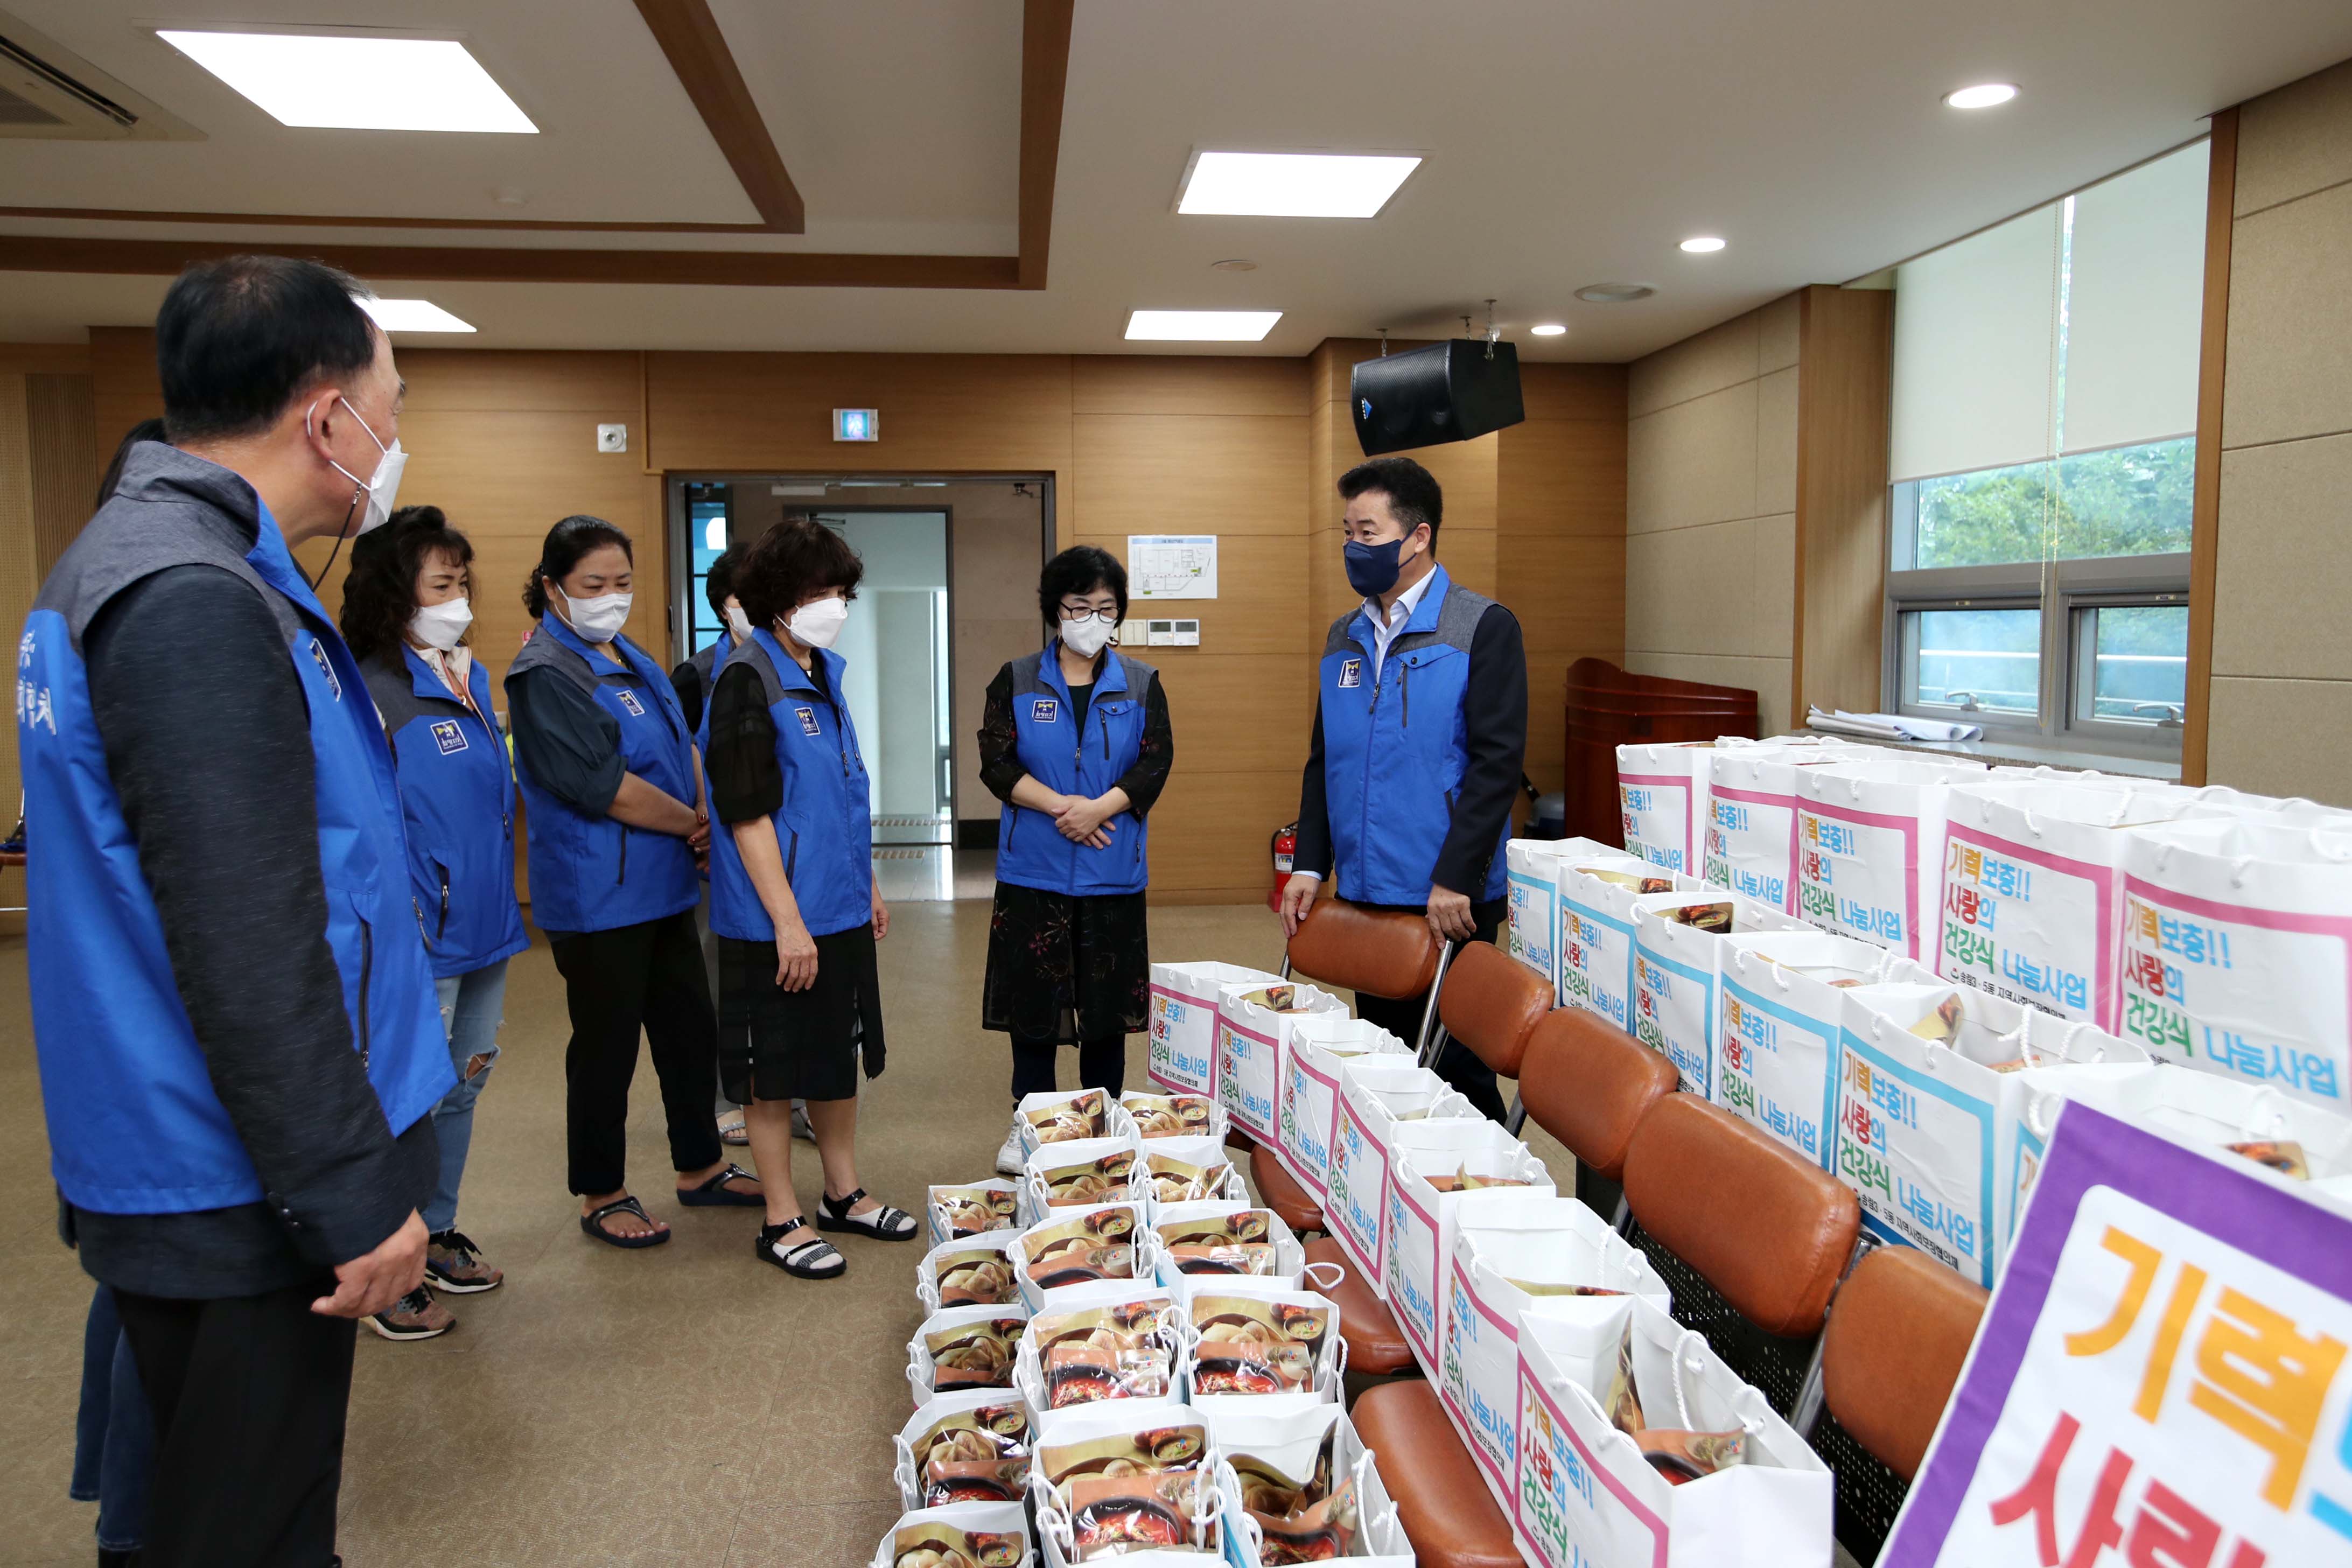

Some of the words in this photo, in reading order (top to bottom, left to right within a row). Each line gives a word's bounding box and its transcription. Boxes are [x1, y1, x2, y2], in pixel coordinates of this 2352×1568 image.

[1707, 825, 1726, 858] 사랑의
[1800, 813, 1854, 856] 기력보충!!
[1706, 855, 1730, 890] 건강식
[1734, 869, 1783, 905] 나눔사업
[1800, 848, 1832, 885] 사랑의
[1950, 843, 2030, 902] 기력보충!!
[1564, 911, 1602, 950] 기력보충!!
[1801, 881, 1836, 921] 건강식
[1840, 898, 1902, 941] 나눔사업
[1945, 882, 1996, 932] 사랑의
[2127, 898, 2231, 969] 기력보충!!
[1524, 940, 1551, 970] 나눔사업
[1564, 939, 1587, 972] 사랑의
[1945, 921, 1994, 974] 건강식
[2003, 948, 2086, 1011] 나눔사업
[2125, 946, 2186, 1006] 사랑의
[1153, 995, 1186, 1024] 기력보충!!
[1564, 965, 1590, 1002] 건강식
[1592, 983, 1624, 1024] 나눔사업
[1636, 982, 1659, 1023] 사랑의
[1724, 992, 1777, 1053] 기력보충!!
[1151, 1039, 1170, 1065] 건강식
[1172, 1050, 1207, 1077] 나눔사업
[1152, 1017, 1171, 1042] 사랑의
[1637, 1012, 1665, 1055] 건강식
[1665, 1036, 1704, 1084] 나눔사업
[1723, 1029, 1753, 1077] 사랑의
[2126, 992, 2193, 1058] 건강식
[2203, 1026, 2341, 1099] 나눔사업
[1221, 1050, 1237, 1077] 사랑의
[1844, 1051, 1917, 1130] 기력보충!!
[1221, 1074, 1239, 1103] 건강식
[1241, 1088, 1271, 1121] 나눔사업
[1285, 1081, 1296, 1116] 사랑의
[1722, 1065, 1755, 1117] 건강식
[1760, 1094, 1817, 1155] 나눔사업
[1841, 1094, 1886, 1154] 사랑의
[1282, 1107, 1296, 1143] 건강식
[1298, 1128, 1327, 1169] 나눔사업
[1335, 1139, 1350, 1178] 사랑의
[1331, 1165, 1348, 1207] 건강식
[1350, 1192, 1376, 1245] 나눔사업
[1840, 1135, 1892, 1202] 건강식
[1897, 1175, 1975, 1257] 나눔사업
[1401, 1269, 1433, 1332] 나눔사업
[1467, 1378, 1514, 1462] 나눔사업
[1525, 1381, 1593, 1510] 기력보충!!
[1524, 1426, 1565, 1515] 사랑의
[1523, 1465, 1567, 1562] 건강식
